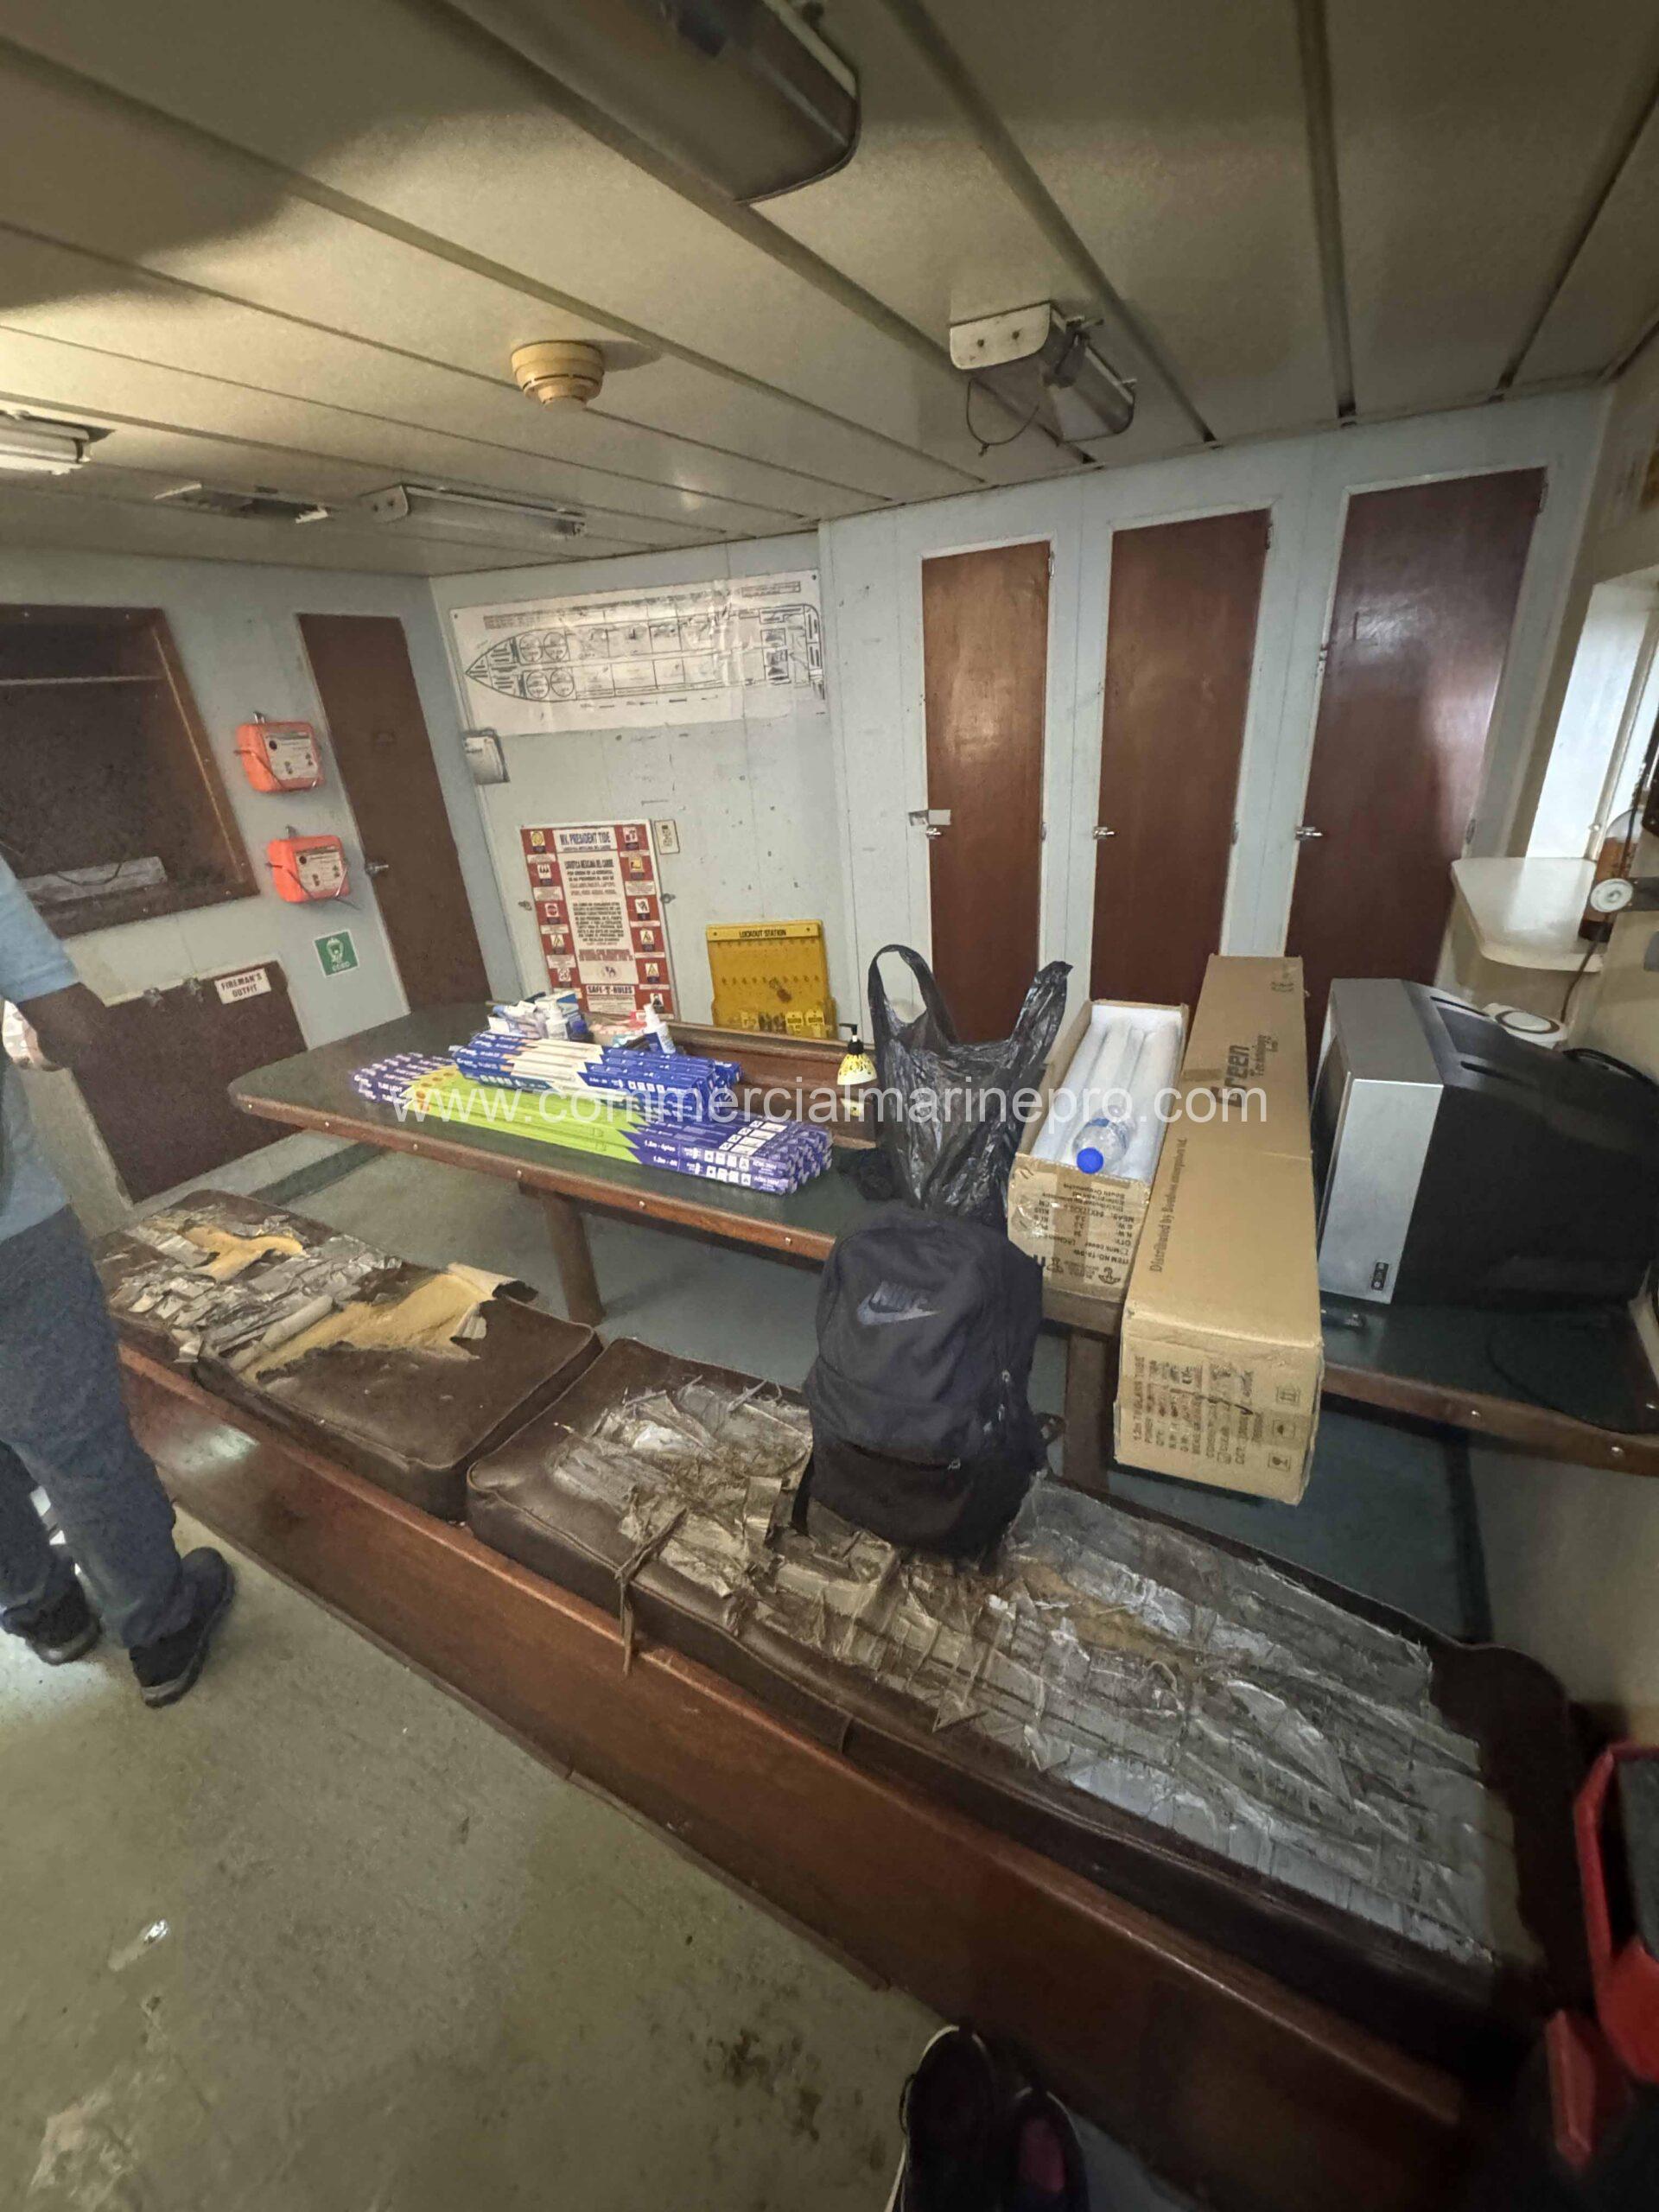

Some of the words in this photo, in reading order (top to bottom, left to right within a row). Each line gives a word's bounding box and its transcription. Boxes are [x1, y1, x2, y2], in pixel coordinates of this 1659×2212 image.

[221, 973, 263, 990] FIREMAN'S
[232, 983, 257, 997] OUTFIT
[1211, 1046, 1250, 1108] Green
[1111, 1255, 1128, 1264] ITEM
